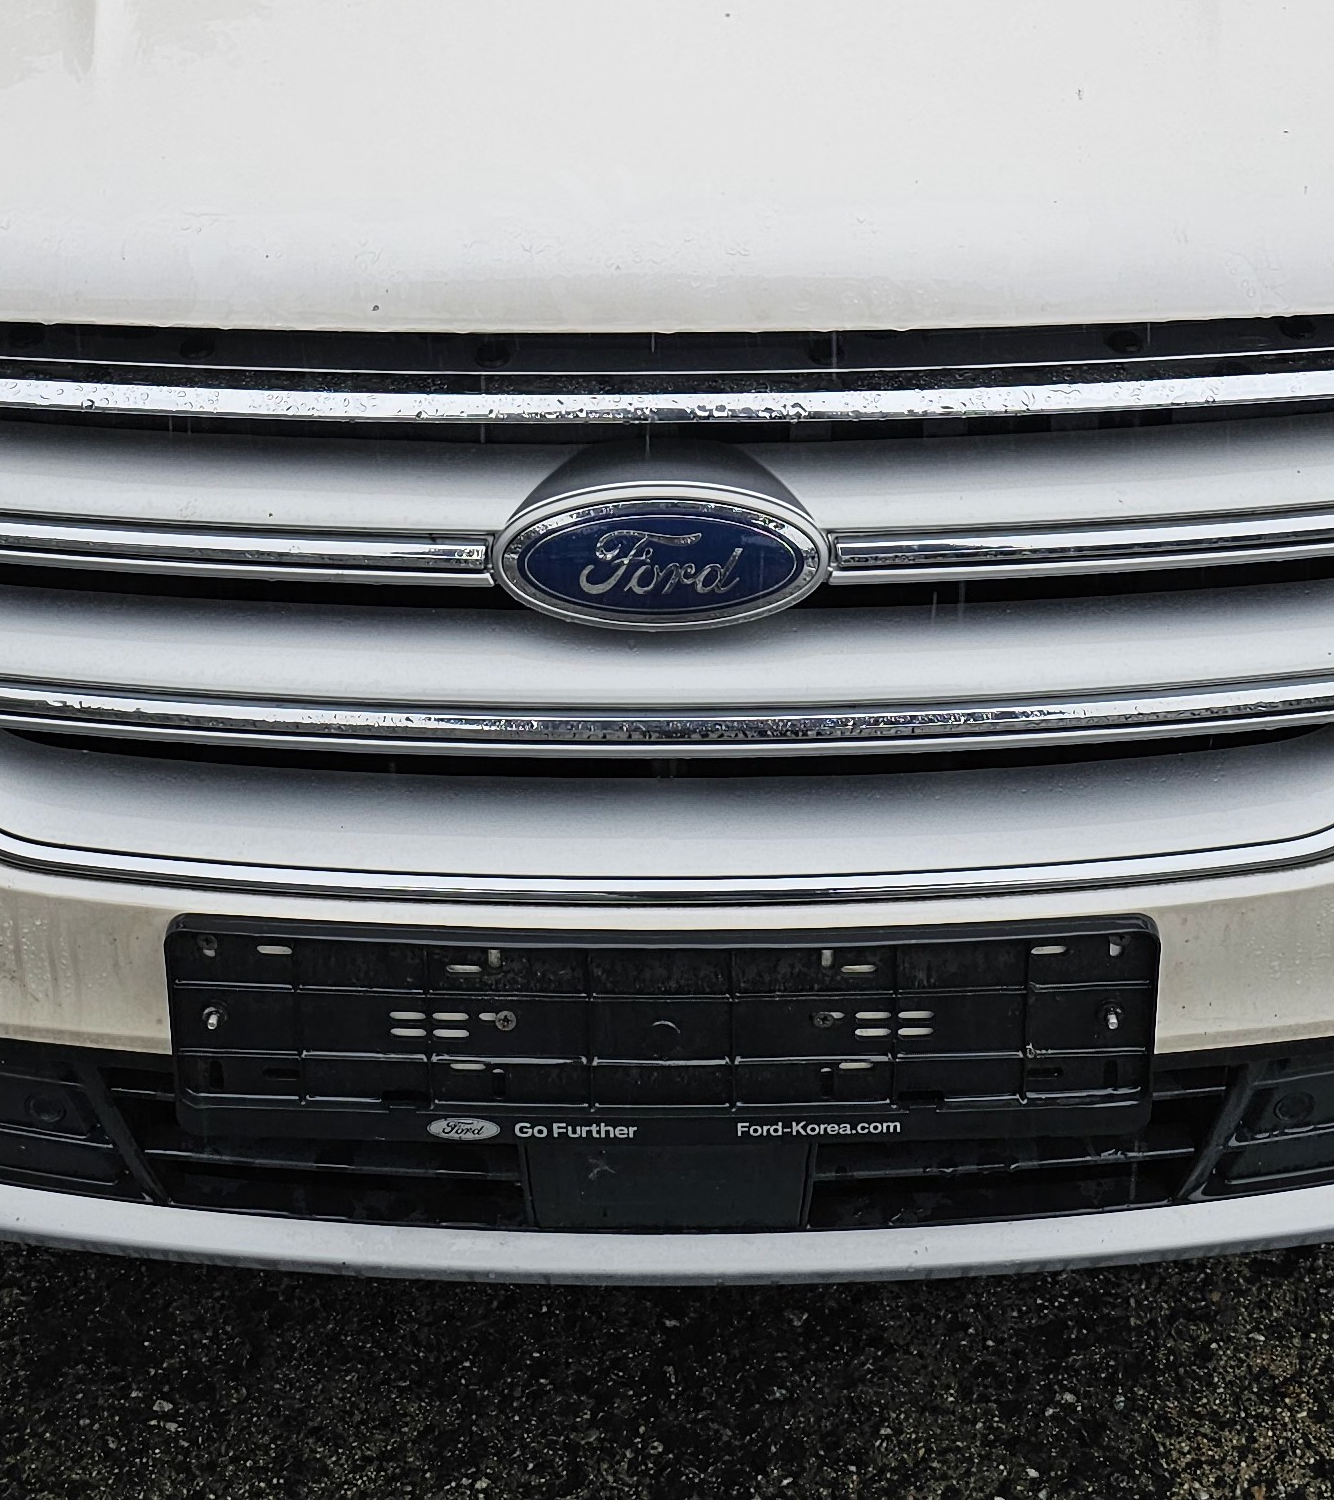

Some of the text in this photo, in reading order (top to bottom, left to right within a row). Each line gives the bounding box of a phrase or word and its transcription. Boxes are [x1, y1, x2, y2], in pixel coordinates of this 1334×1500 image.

[579, 529, 743, 595] Ford
[442, 1121, 637, 1139] Ford Go Further
[737, 1121, 901, 1137] Ford-Korea.com
